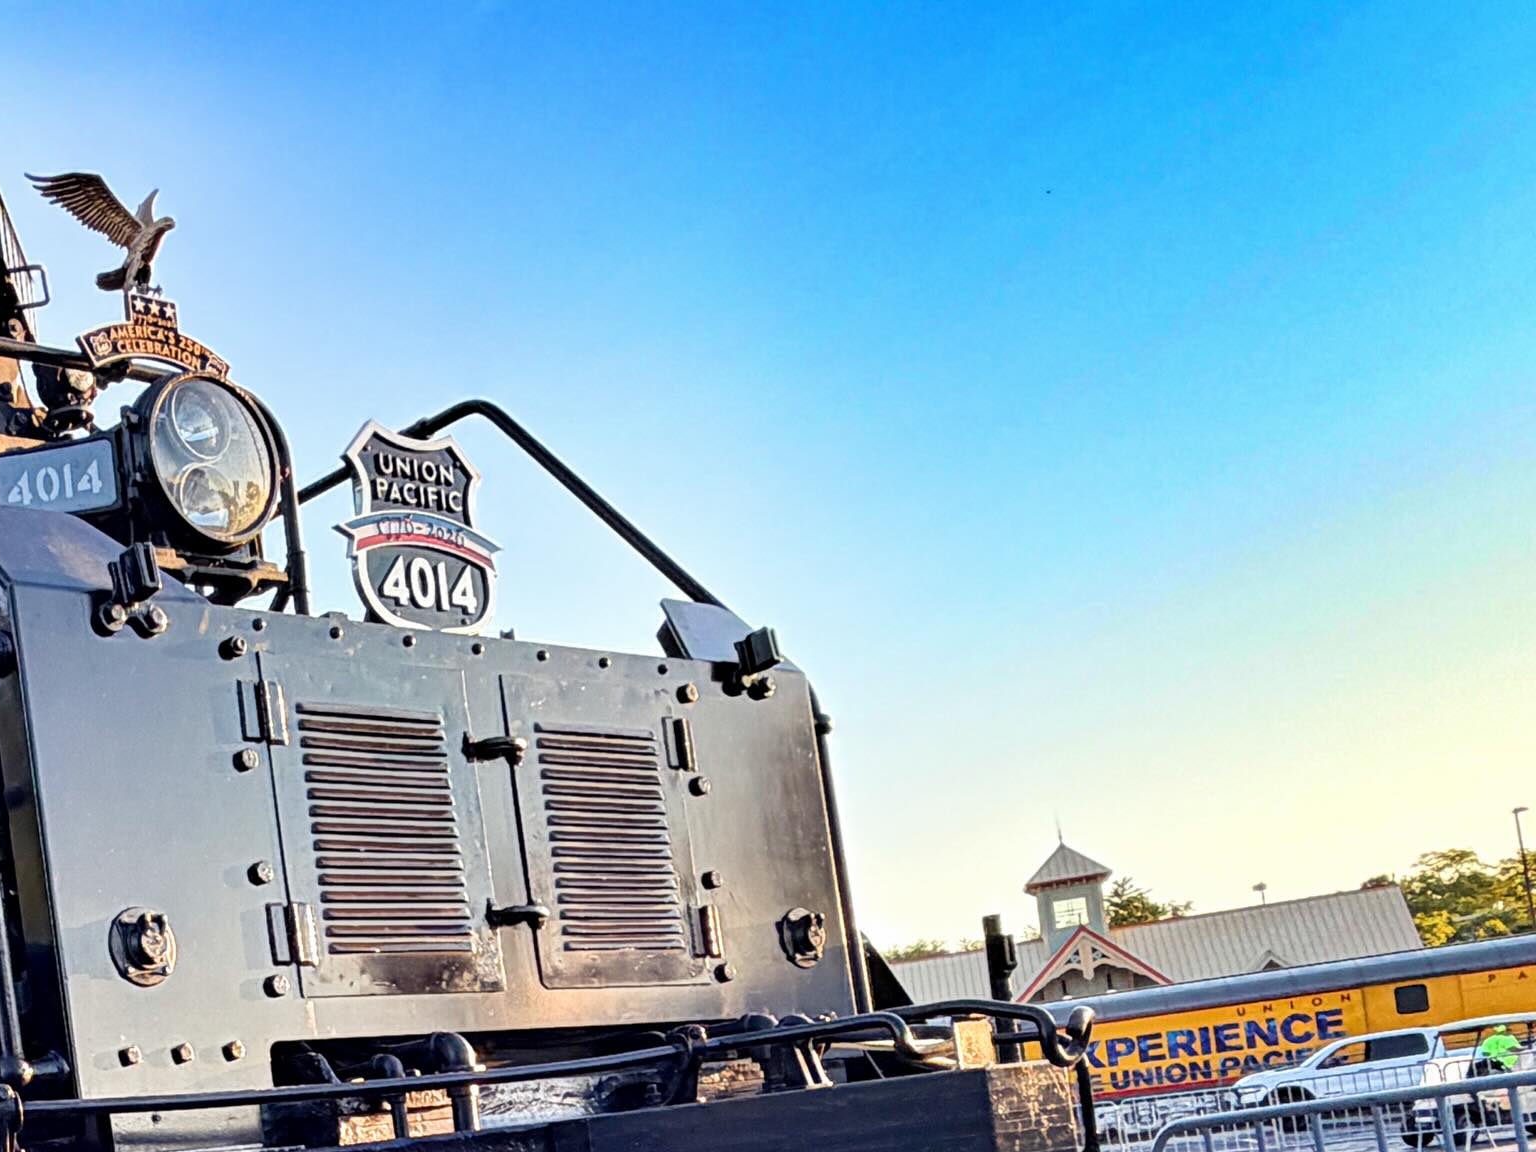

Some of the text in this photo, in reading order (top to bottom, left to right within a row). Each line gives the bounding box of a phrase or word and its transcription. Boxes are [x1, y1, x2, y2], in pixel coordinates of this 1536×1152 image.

[110, 325, 176, 344] AMERICA'S
[117, 339, 201, 370] CELEBRATION
[8, 459, 103, 506] 4014
[378, 452, 454, 484] UNION
[376, 478, 463, 512] PACIFIC
[383, 555, 478, 614] 4014
[1237, 993, 1351, 1017] UNION
[1086, 1008, 1344, 1069] XPERIENCE
[1110, 1061, 1212, 1090] UNION
